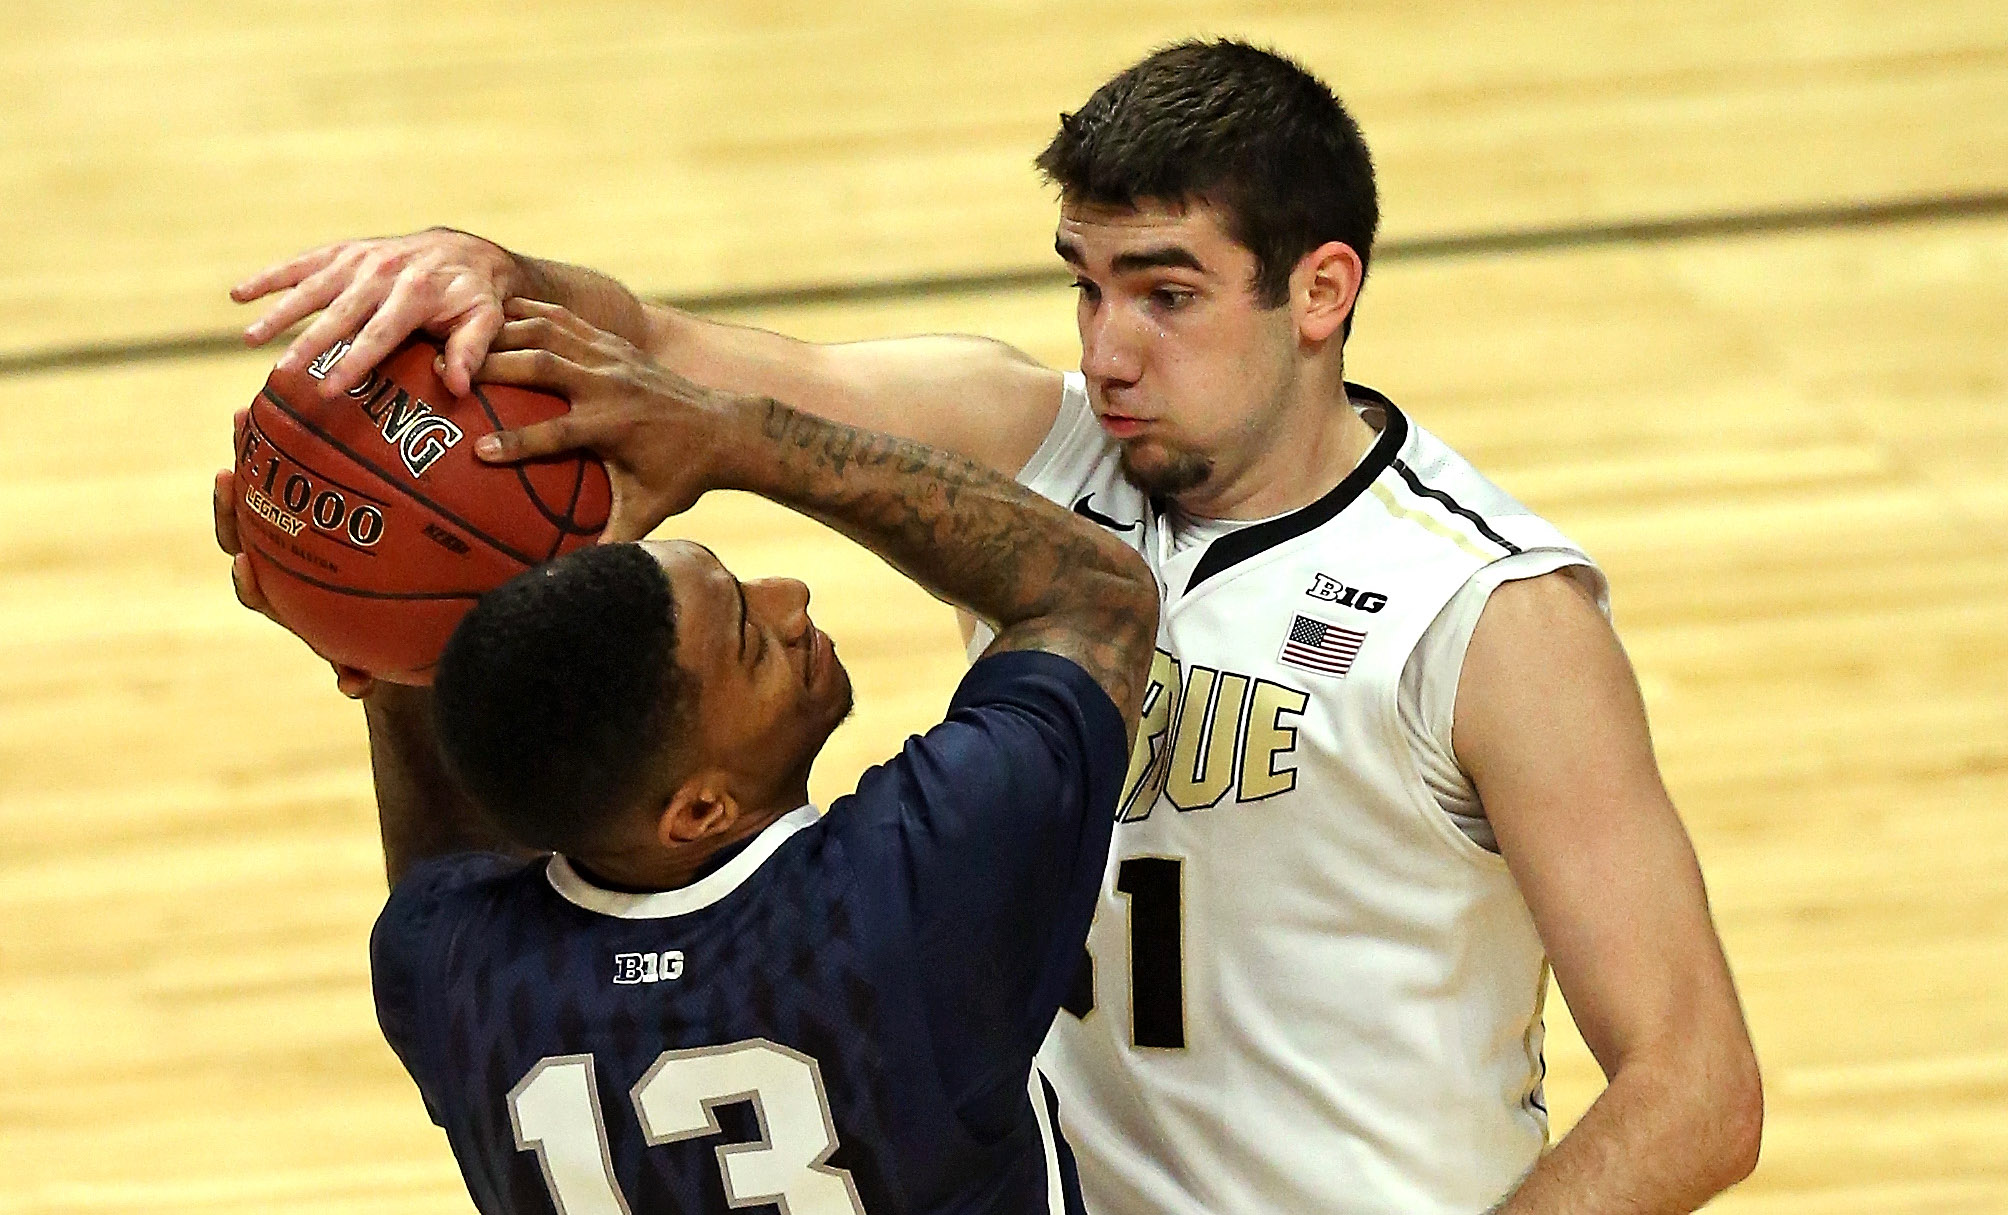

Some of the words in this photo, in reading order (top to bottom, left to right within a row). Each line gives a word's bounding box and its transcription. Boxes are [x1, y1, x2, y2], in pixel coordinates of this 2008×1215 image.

[245, 484, 307, 538] LEGACY
[1113, 648, 1310, 823] RUE
[506, 1037, 866, 1215] 13
